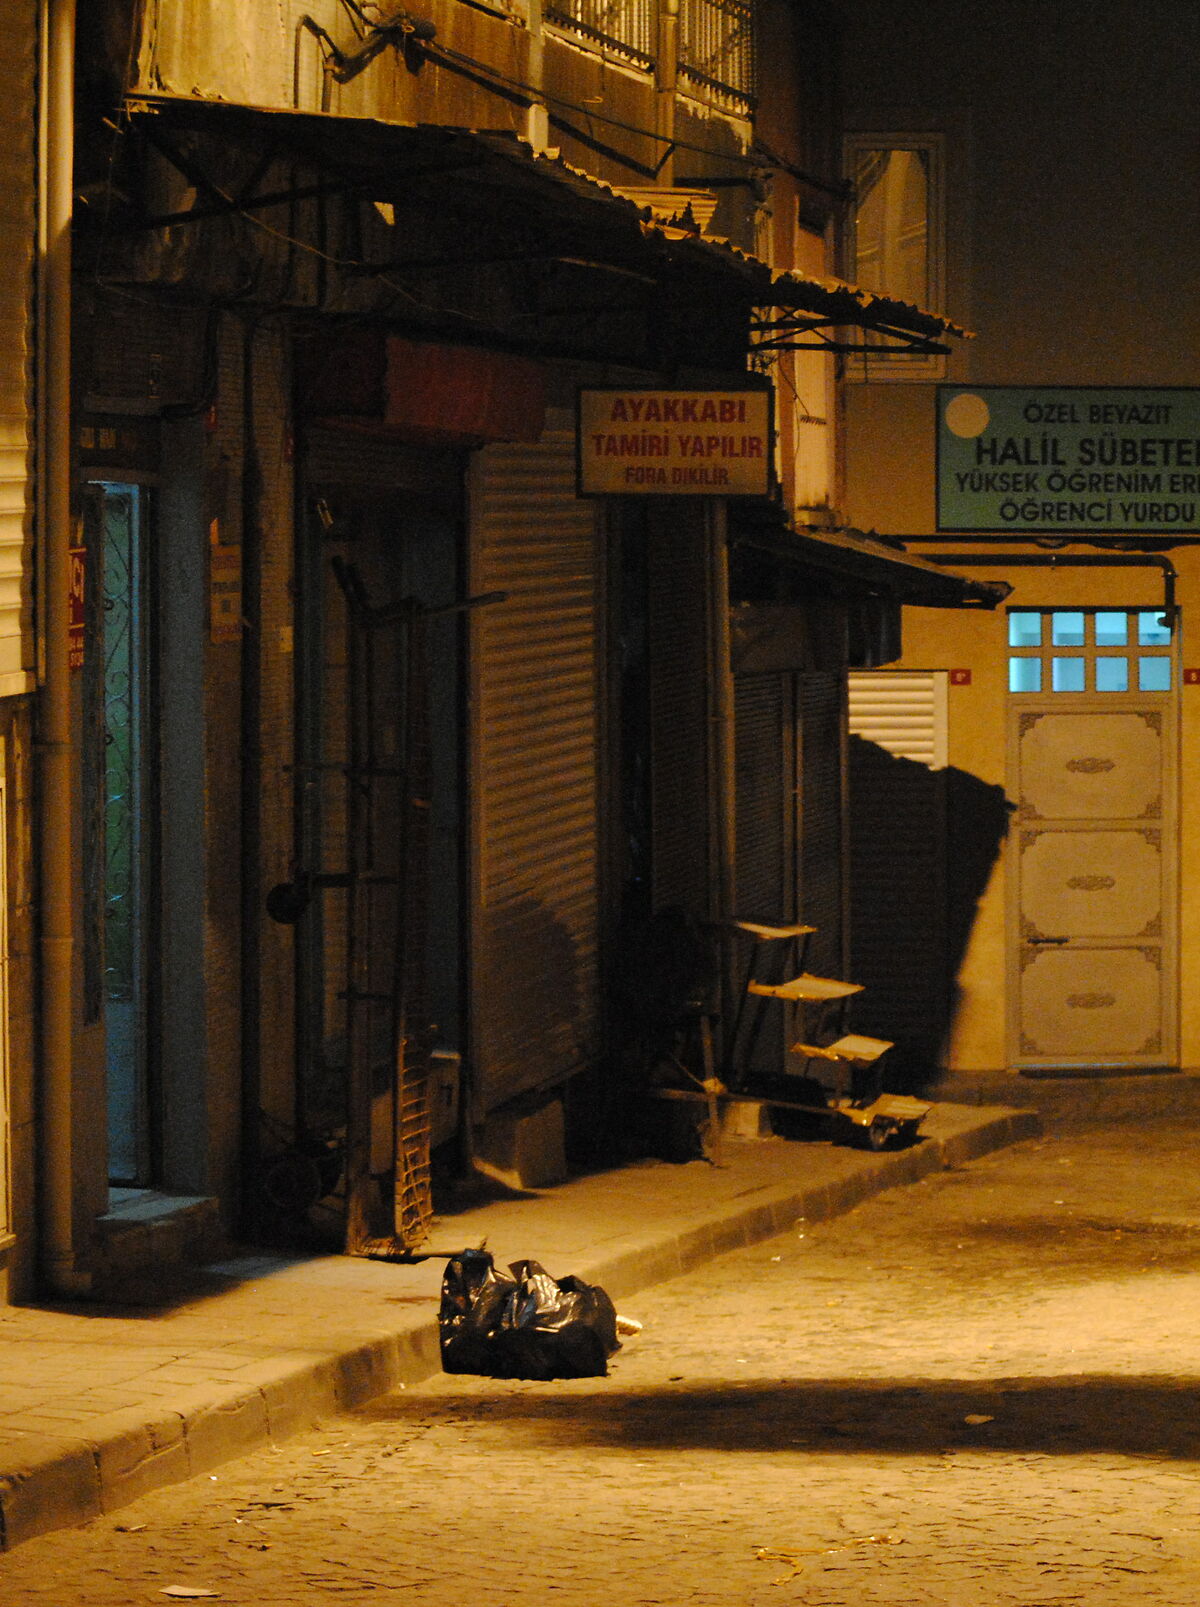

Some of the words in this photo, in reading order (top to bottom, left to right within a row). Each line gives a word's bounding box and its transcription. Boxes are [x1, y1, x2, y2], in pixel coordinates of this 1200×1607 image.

[611, 398, 746, 422] AYAKKABI
[1023, 398, 1080, 424] ÖZEL
[678, 435, 762, 458] YAPILIR
[975, 432, 1066, 467] HALİL
[955, 469, 1040, 493] YÜKSEK
[1046, 469, 1162, 494] ÖĞRENİM
[1000, 499, 1112, 522] ÖĞRENCİ
[1120, 502, 1196, 523] YURDU
